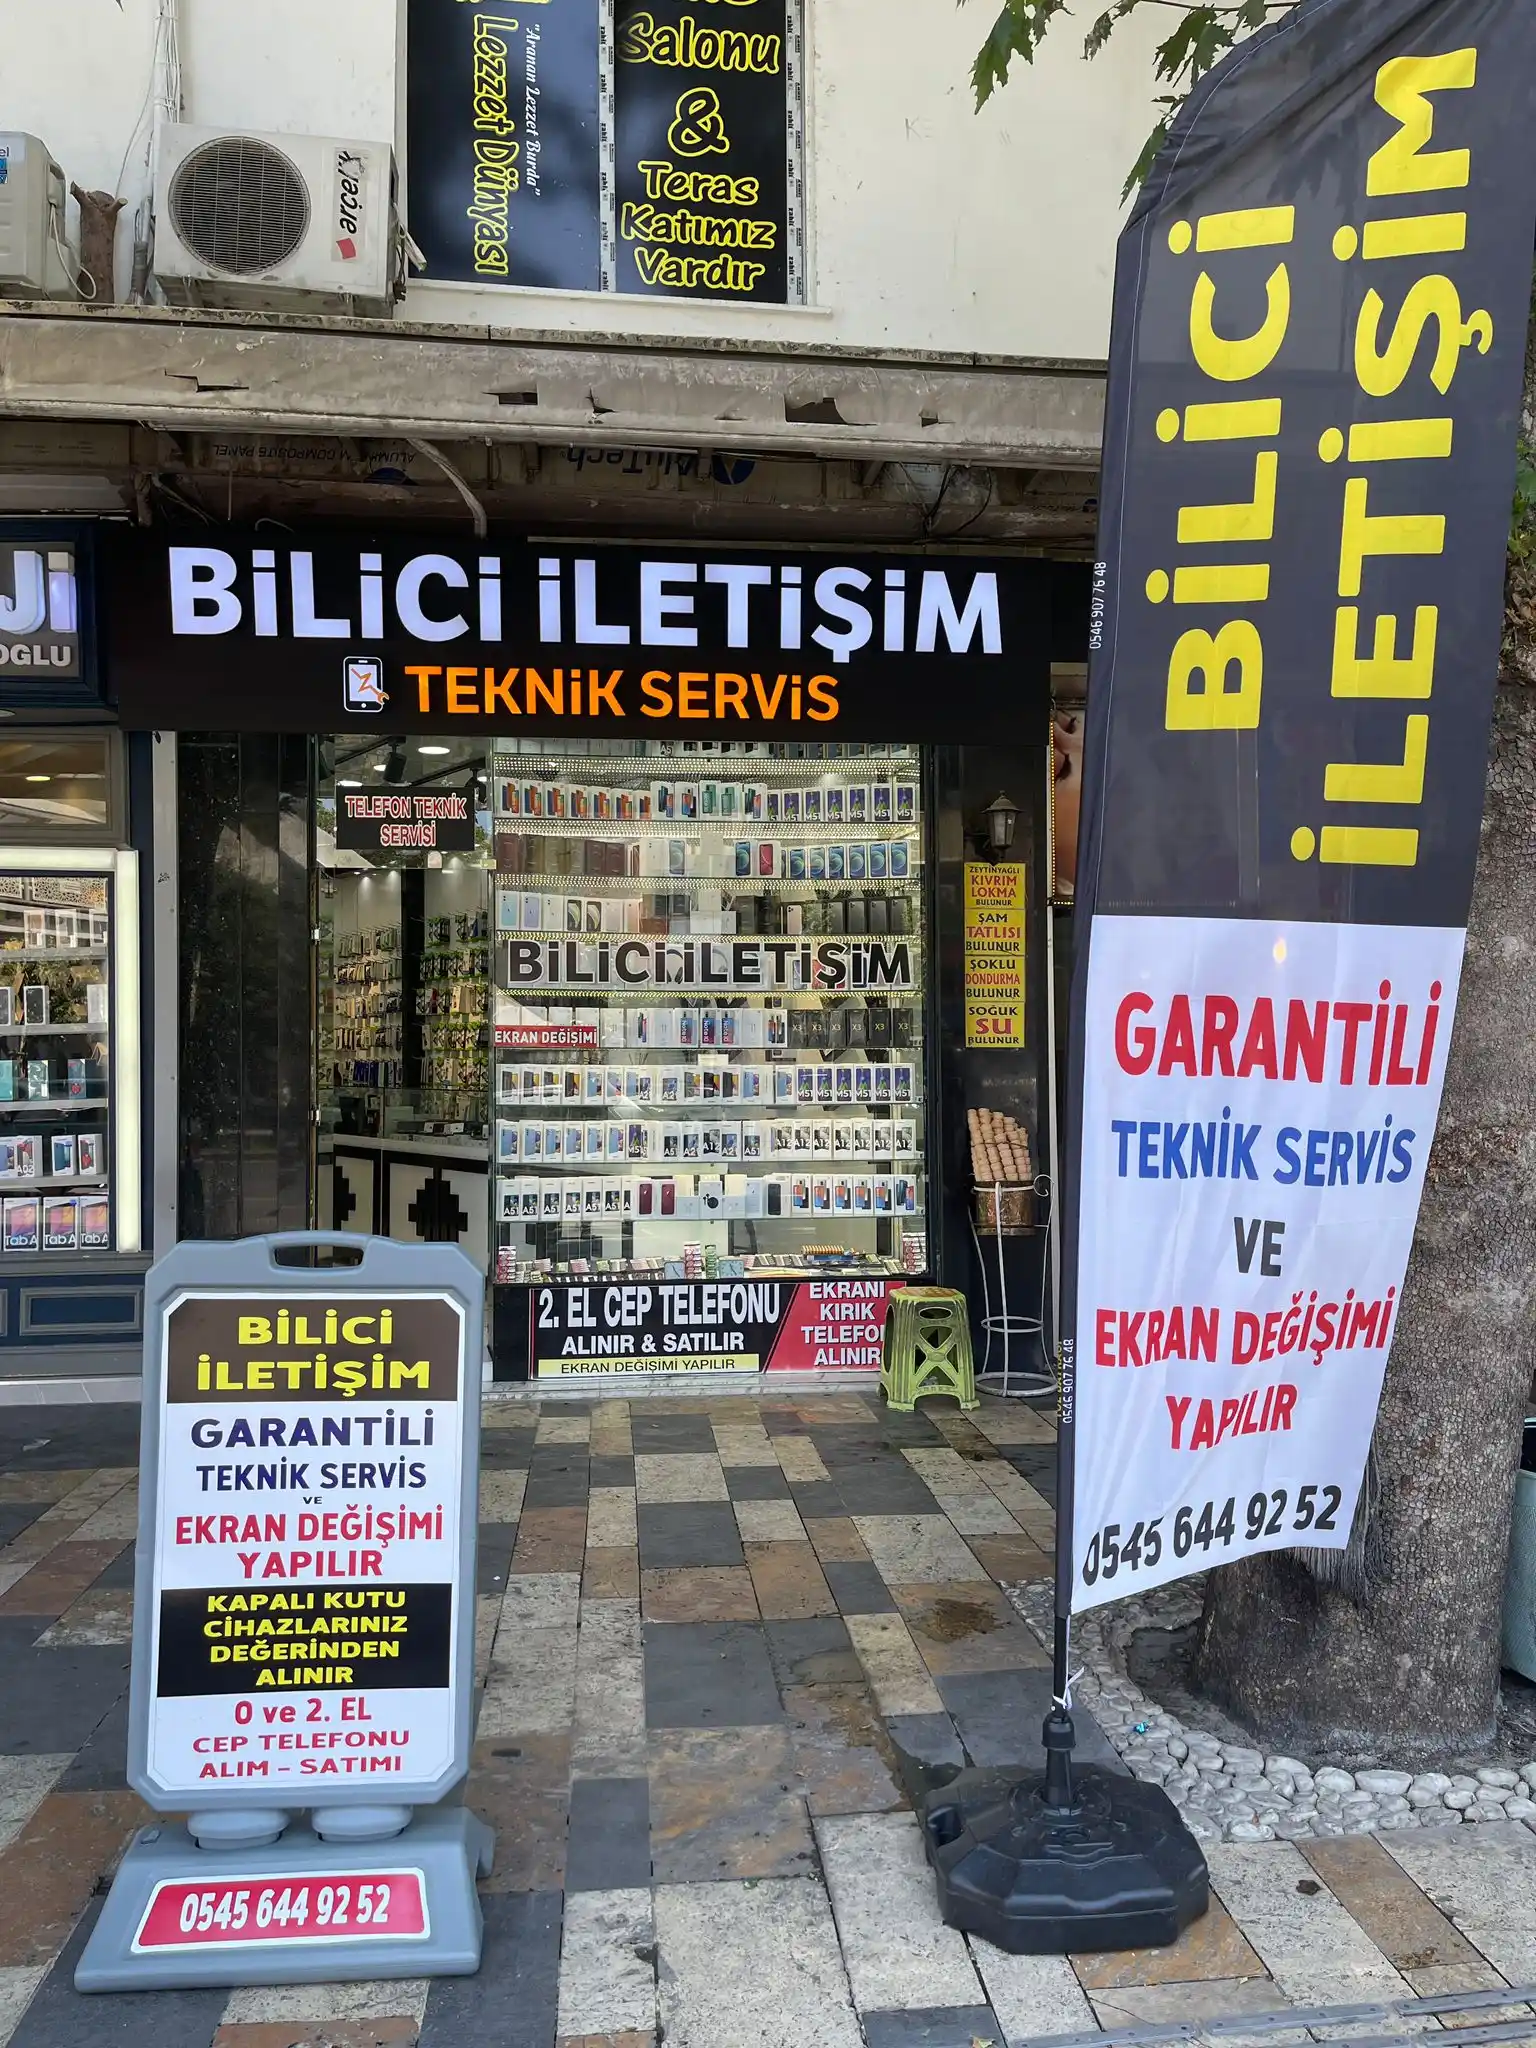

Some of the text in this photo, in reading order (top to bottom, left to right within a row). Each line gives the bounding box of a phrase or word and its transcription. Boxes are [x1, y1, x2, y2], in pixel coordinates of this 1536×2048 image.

[618, 11, 781, 74] Salonu
[473, 13, 519, 135] Lezzet
[525, 86, 541, 136] Lezzet
[667, 86, 730, 157] &
[337, 150, 363, 234] arçelk
[637, 160, 760, 206] Teras
[467, 139, 519, 276] Dünyası
[620, 202, 777, 249] Katımız
[634, 246, 766, 291] Vardır
[212, 445, 255, 457] PANEL
[1290, 47, 1494, 867] İLETİŞİM
[1145, 205, 1296, 731] BİLİCİ
[1089, 561, 1107, 649] 0546 907 76 48
[345, 792, 468, 819] TELEFON TEKNİK
[380, 820, 437, 847] SERVİSİ
[971, 875, 1017, 886] KIVRIM
[971, 887, 1017, 898] LOKMA
[978, 913, 1008, 924] ŞAM
[966, 926, 1021, 939] TATLISI
[966, 941, 1020, 952] BULUNUR
[965, 973, 1021, 985] DONDURMA
[970, 959, 1016, 972] ŞOKLU
[966, 988, 1020, 999] BULUNUR
[968, 1005, 1018, 1016] SOĞUK
[495, 1028, 597, 1047] EKRAN DEĞİŞİMİ
[975, 1018, 1012, 1035] SU
[1114, 979, 1443, 1086] GARANTİLİ
[968, 1036, 1020, 1045] BULUNUR
[1111, 1105, 1417, 1187] TEKNİK SERVİS
[4, 1233, 29, 1246] Tab
[44, 1233, 67, 1245] Tab
[80, 1233, 101, 1244] Tab
[1233, 1216, 1286, 1277] VE
[809, 1281, 885, 1299] EKRANI
[538, 1283, 780, 1329] 2. EL CEP TELEFONU
[819, 1302, 876, 1321] KIRIK
[238, 1308, 392, 1345] BİLİCİ
[1095, 1285, 1396, 1368] EKRAN DEĞİŞİMİ
[561, 1331, 745, 1355] ALINIR & SATILIR
[813, 1347, 881, 1366] ALINIR
[197, 1352, 430, 1397] İLETİŞİM
[561, 1357, 735, 1374] EKRAN DEĞİŞİMİ YAPILIR
[1062, 1338, 1074, 1424] 0546 907 76 48
[191, 1408, 434, 1449] GARANTİLİ
[1165, 1383, 1298, 1451] YAPILIR
[196, 1455, 426, 1491] TEKNİK SERVİS
[302, 1496, 323, 1505] VE
[175, 1503, 443, 1549] EKRAN DEĞİŞİMİ
[1082, 1484, 1343, 1587] 0545 644 92 52
[237, 1550, 384, 1579] YAPILIR
[207, 1591, 406, 1613] KAPALI KUTU
[203, 1615, 408, 1638] CİHAZLARINIZ
[210, 1639, 400, 1663] DEĞERİNDEN
[255, 1666, 354, 1686] ALINIR
[262, 1704, 296, 1723] ve
[305, 1697, 331, 1722] 2.
[340, 1696, 372, 1721] EL
[192, 1729, 410, 1753] CEP TELEFONU
[199, 1759, 269, 1779] ALIM
[299, 1755, 402, 1775] SATIMI
[179, 1884, 391, 1933] 0545 644 92 52
